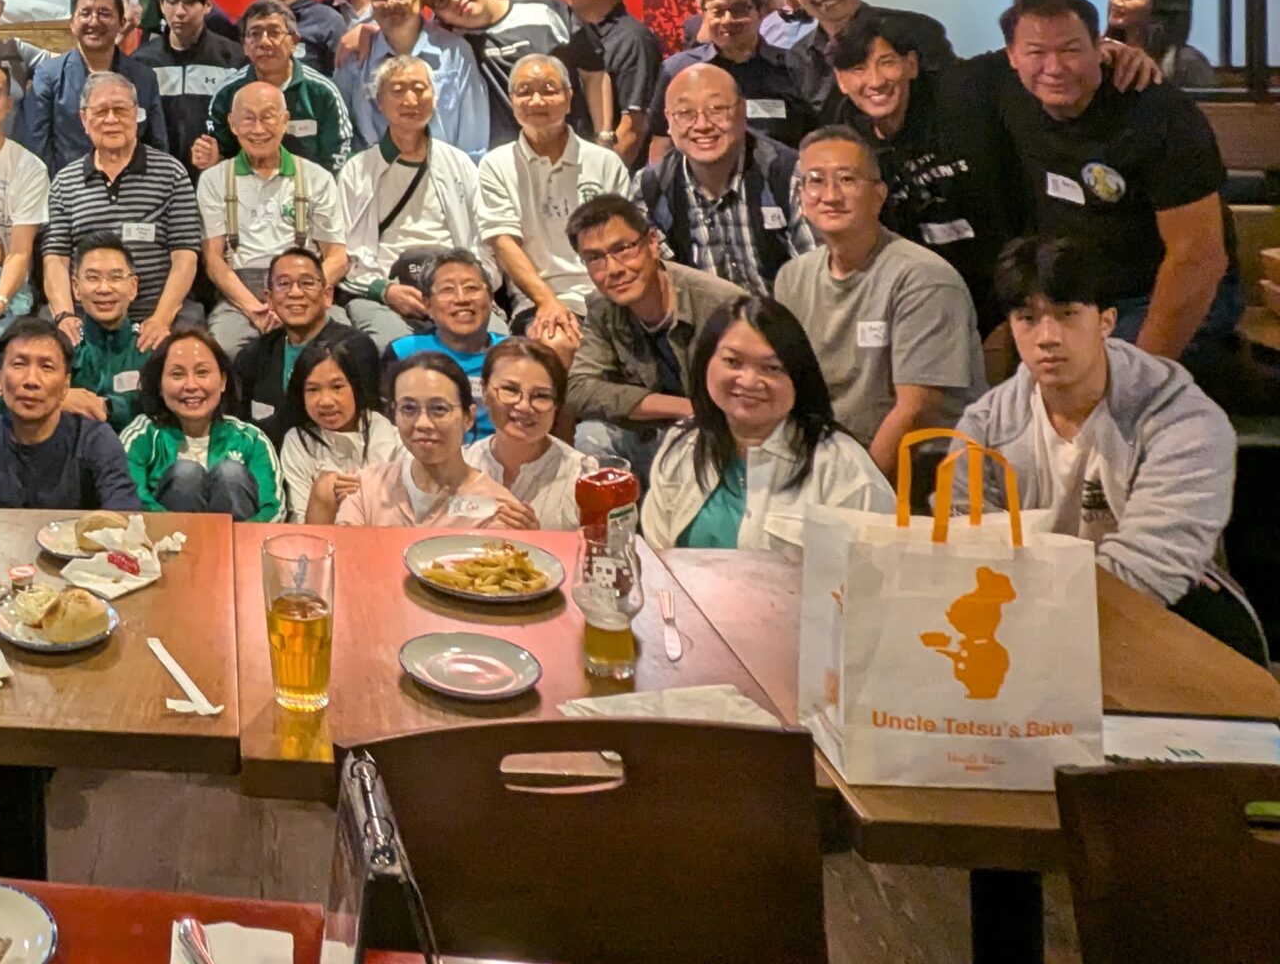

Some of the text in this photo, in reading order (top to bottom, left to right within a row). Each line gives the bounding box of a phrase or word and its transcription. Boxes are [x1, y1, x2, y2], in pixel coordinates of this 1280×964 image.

[871, 710, 1074, 738] Uncle Tetsu's Bake
